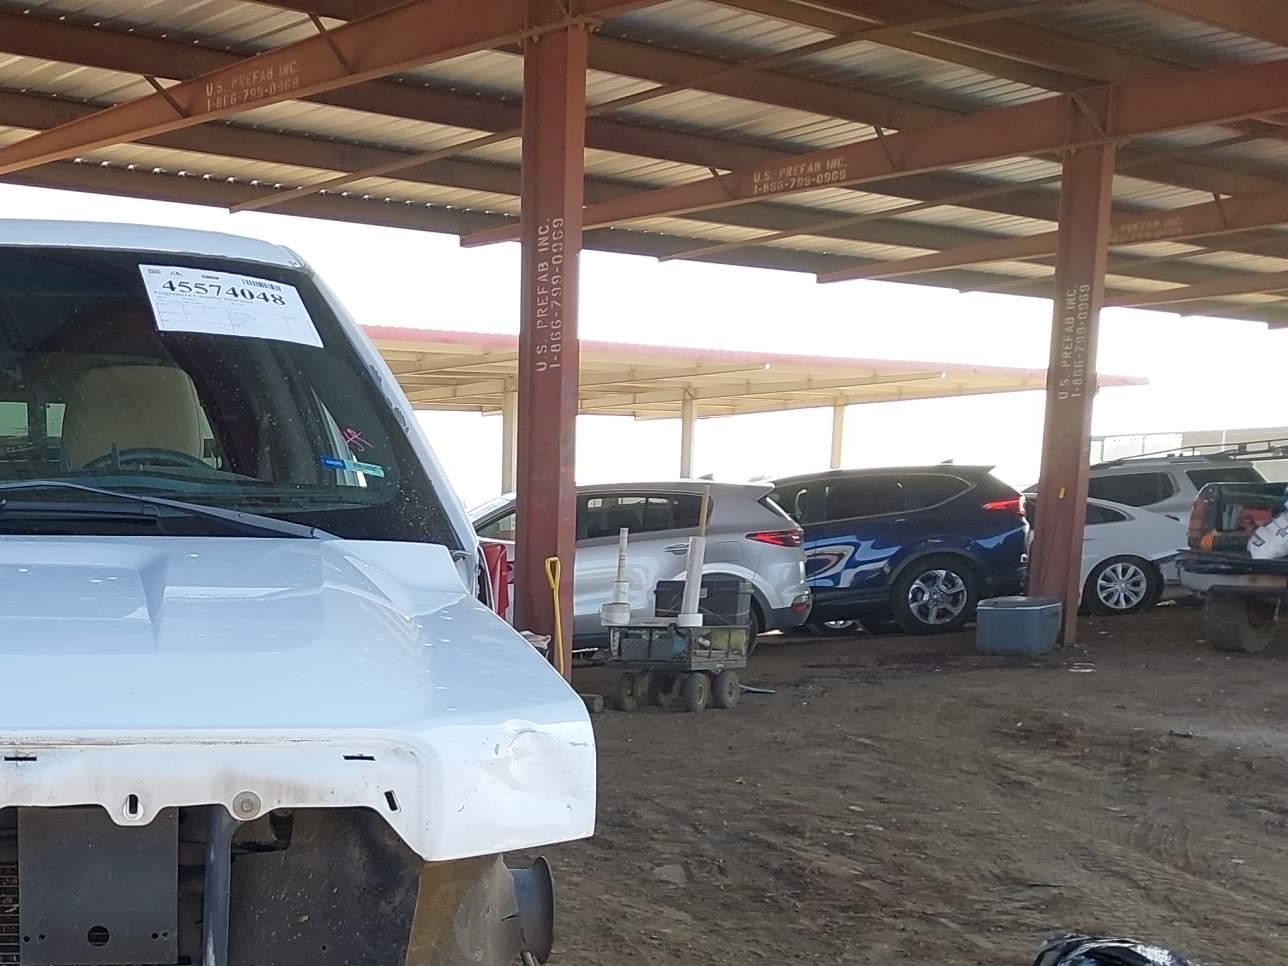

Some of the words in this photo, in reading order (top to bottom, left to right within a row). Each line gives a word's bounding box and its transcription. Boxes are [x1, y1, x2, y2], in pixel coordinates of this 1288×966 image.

[538, 217, 551, 252] INC.
[162, 279, 287, 306] 45574048
[536, 262, 550, 329] PREFAB
[549, 217, 564, 368] 1-866-799-0969
[535, 338, 548, 372] U.S.
